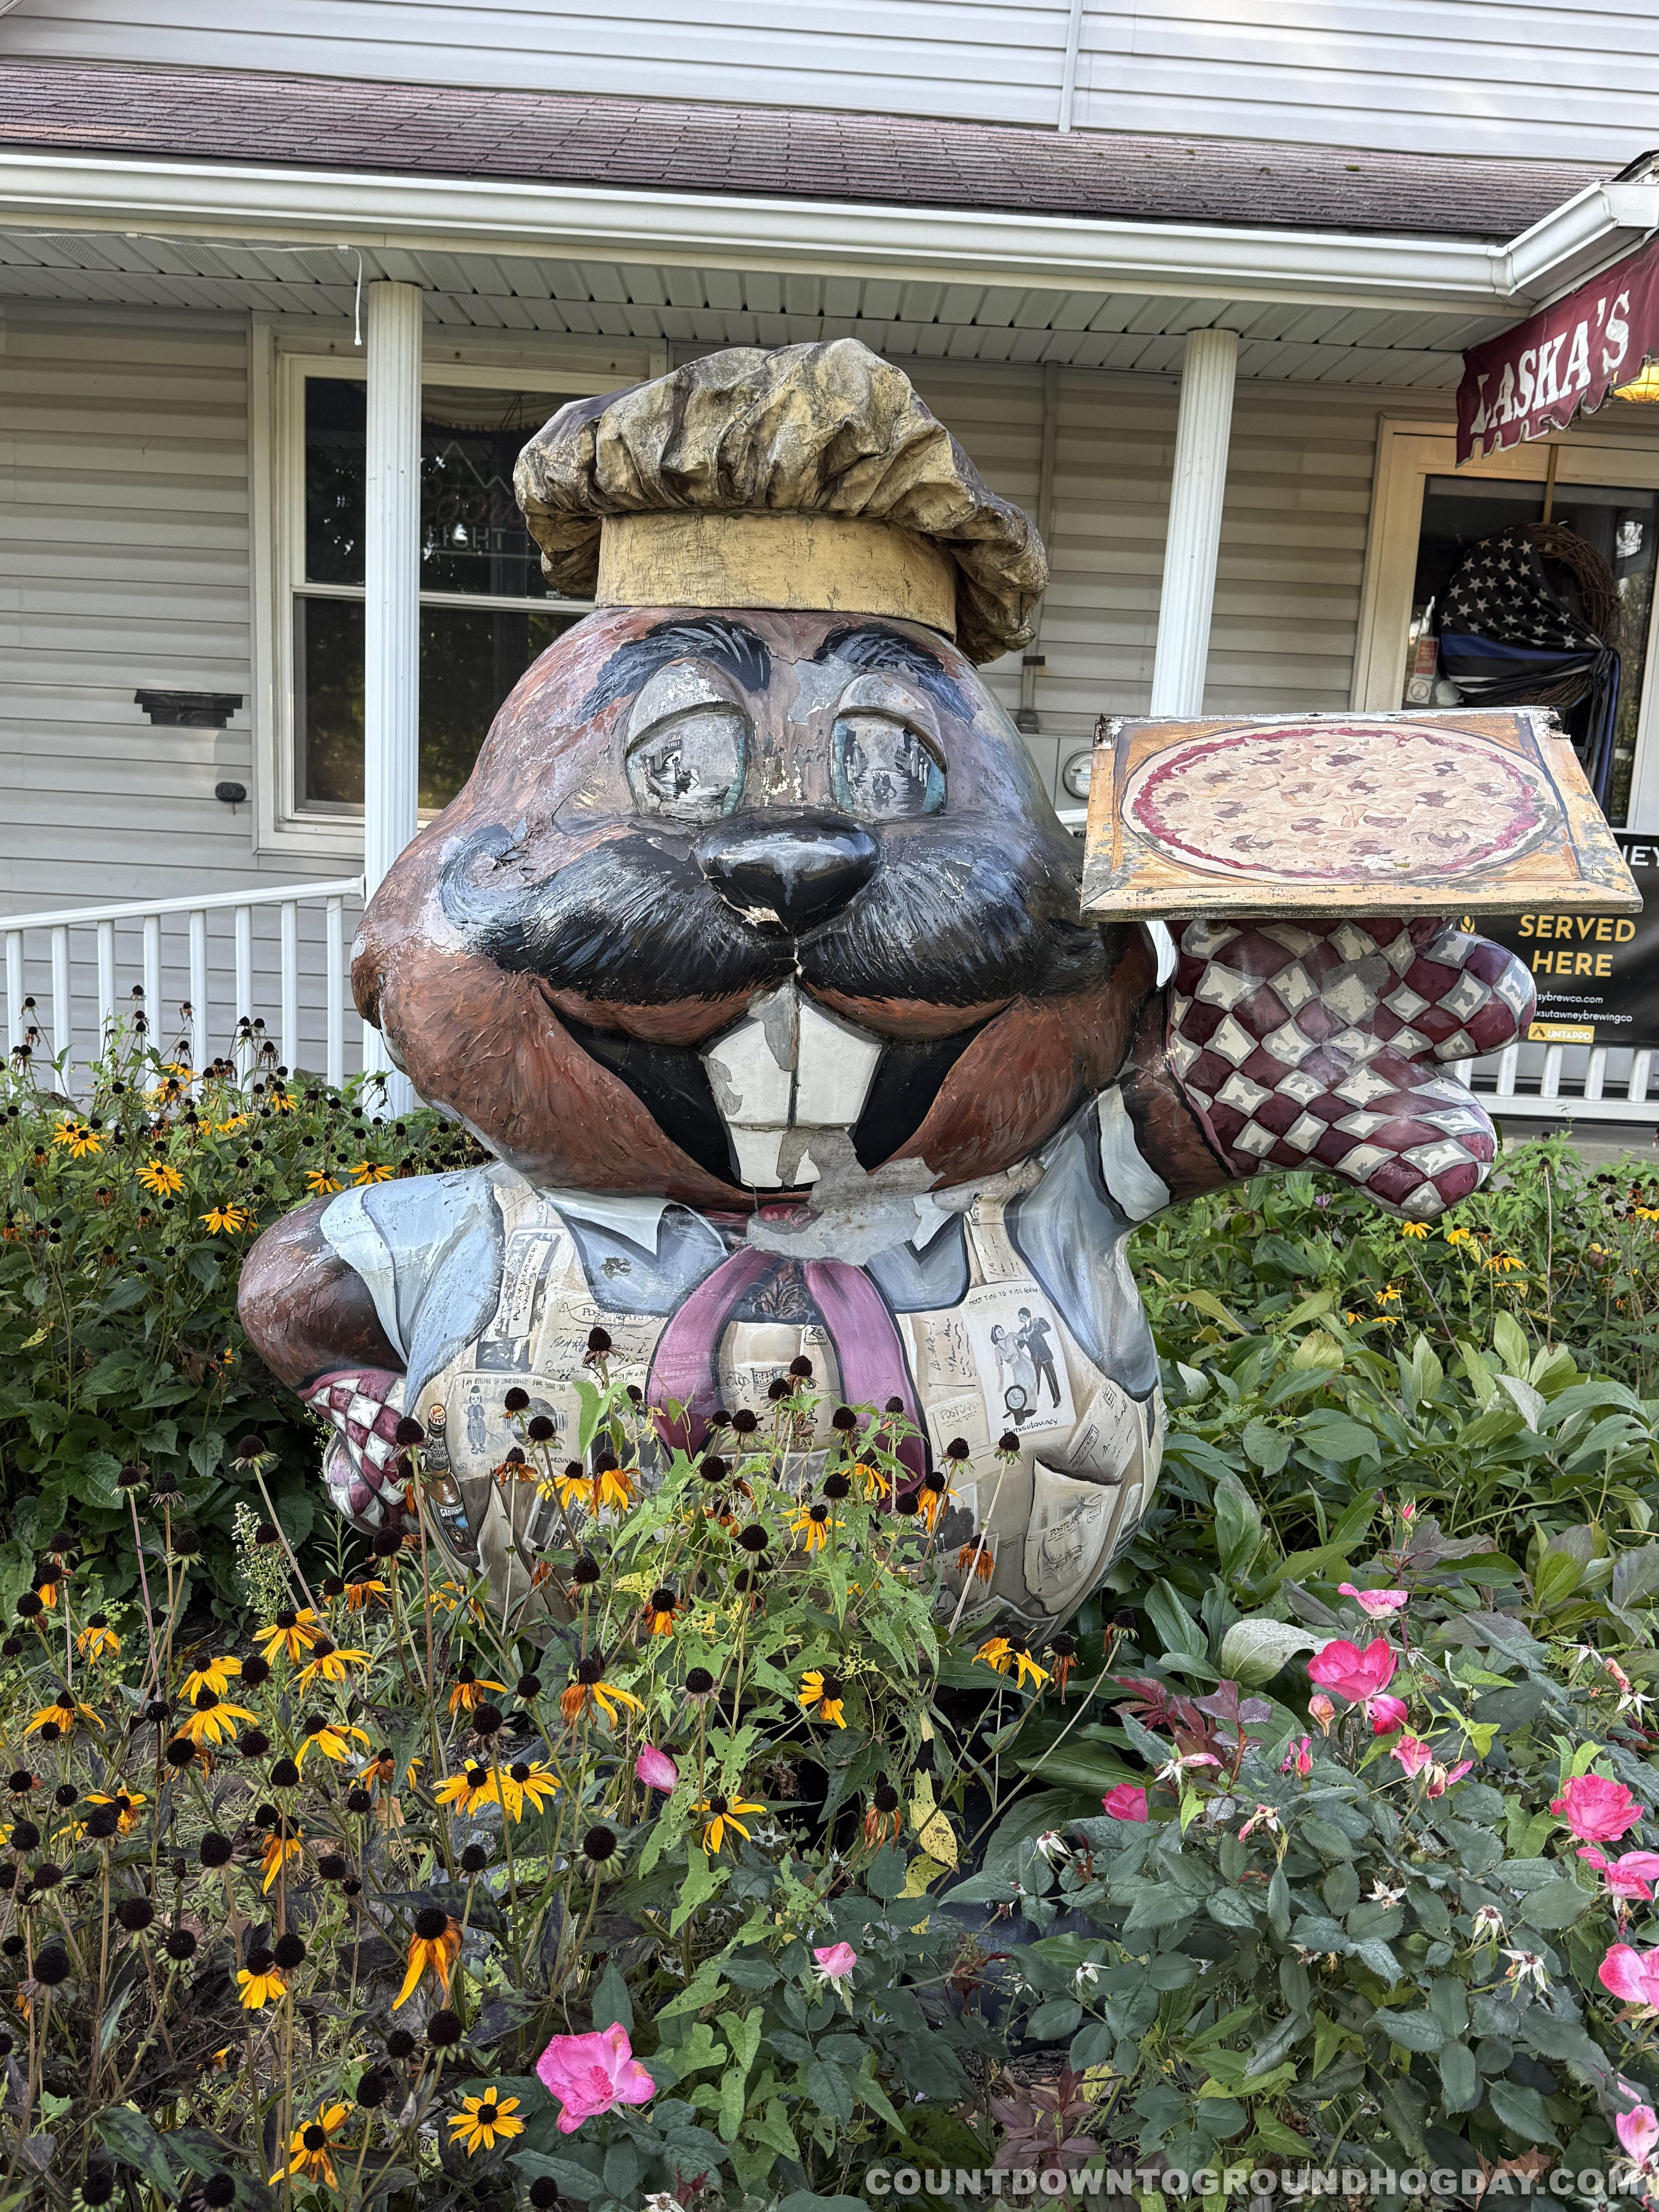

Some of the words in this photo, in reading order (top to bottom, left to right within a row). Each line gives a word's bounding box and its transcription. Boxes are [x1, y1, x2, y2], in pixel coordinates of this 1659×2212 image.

[1470, 290, 1630, 434] LASKA'S
[1518, 914, 1635, 942] SERVED
[1532, 950, 1613, 977] HERE
[1537, 991, 1603, 1004] sybrewco.com
[1535, 1009, 1632, 1024] xsutawneybrewingco
